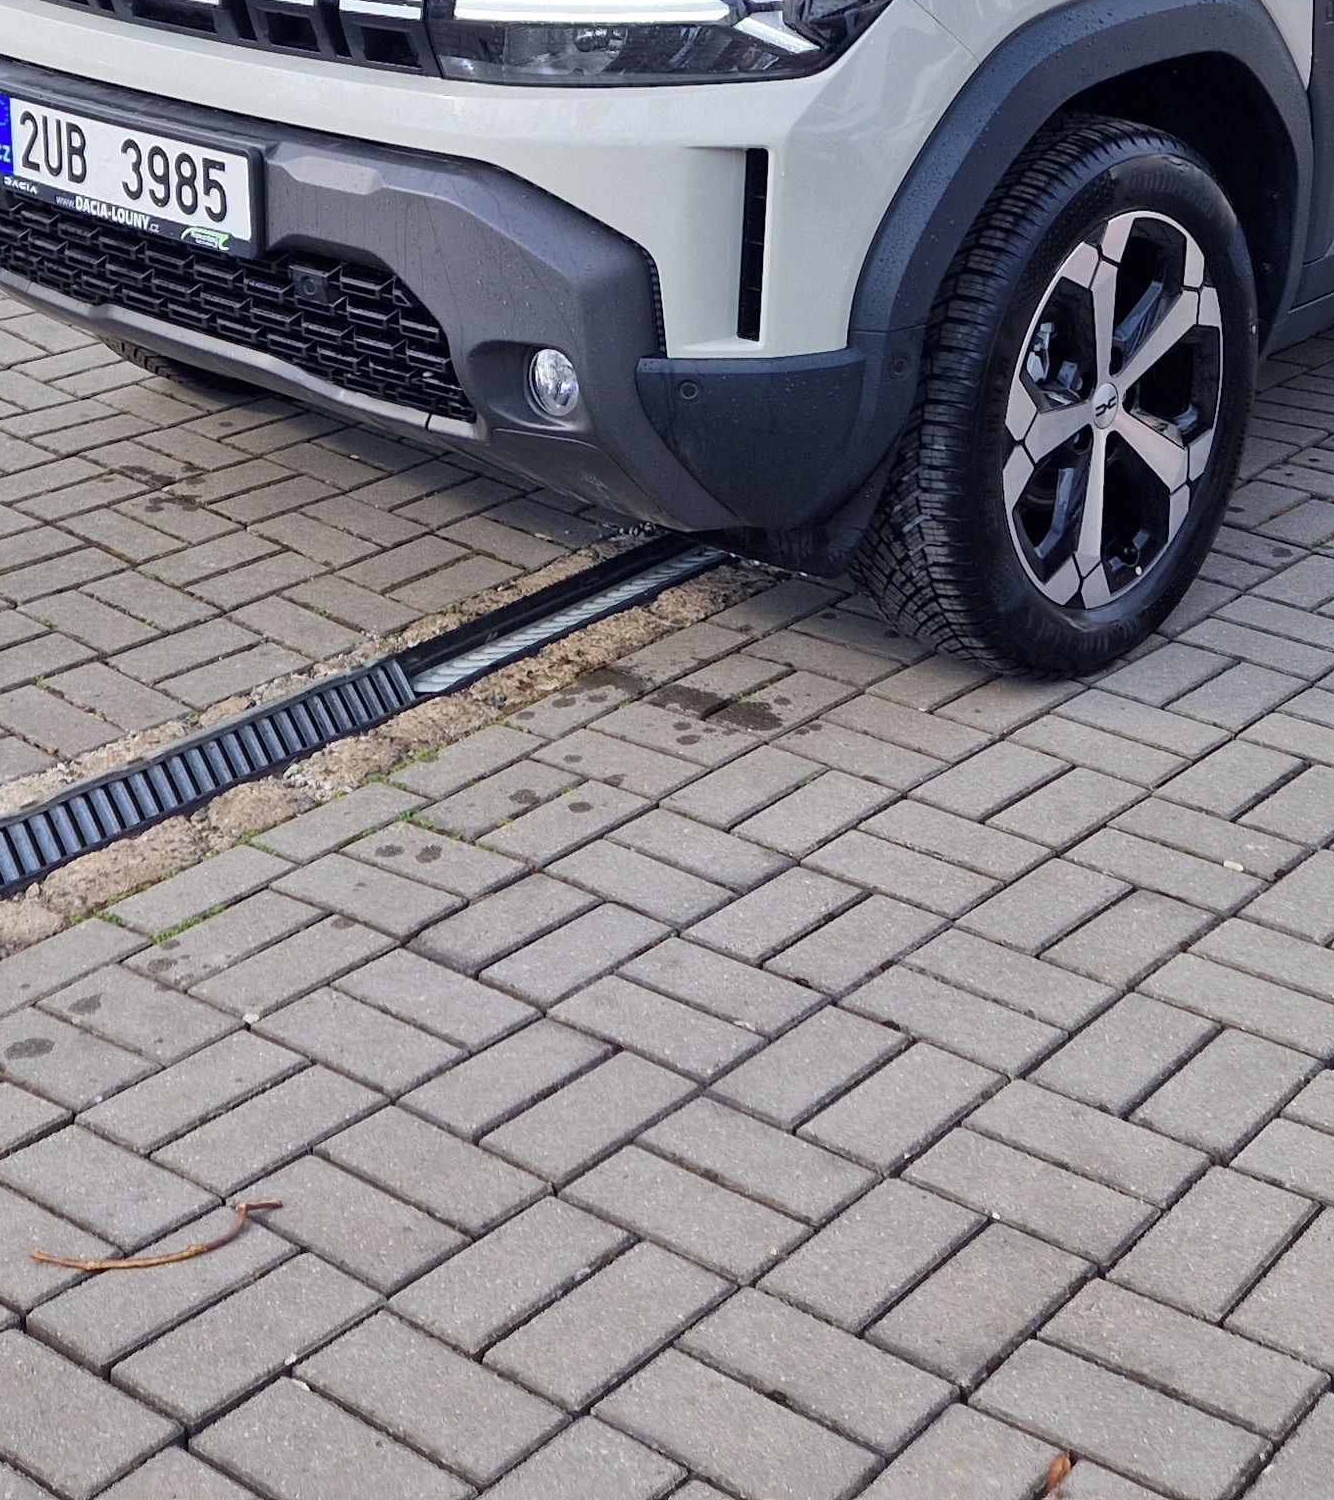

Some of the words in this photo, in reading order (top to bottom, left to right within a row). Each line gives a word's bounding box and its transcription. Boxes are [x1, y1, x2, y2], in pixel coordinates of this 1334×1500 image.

[3, 176, 38, 195] DACIA
[19, 110, 87, 184] 2UB
[121, 138, 228, 223] 3985
[55, 195, 160, 233] www.DACIA-LOUNY.cz
